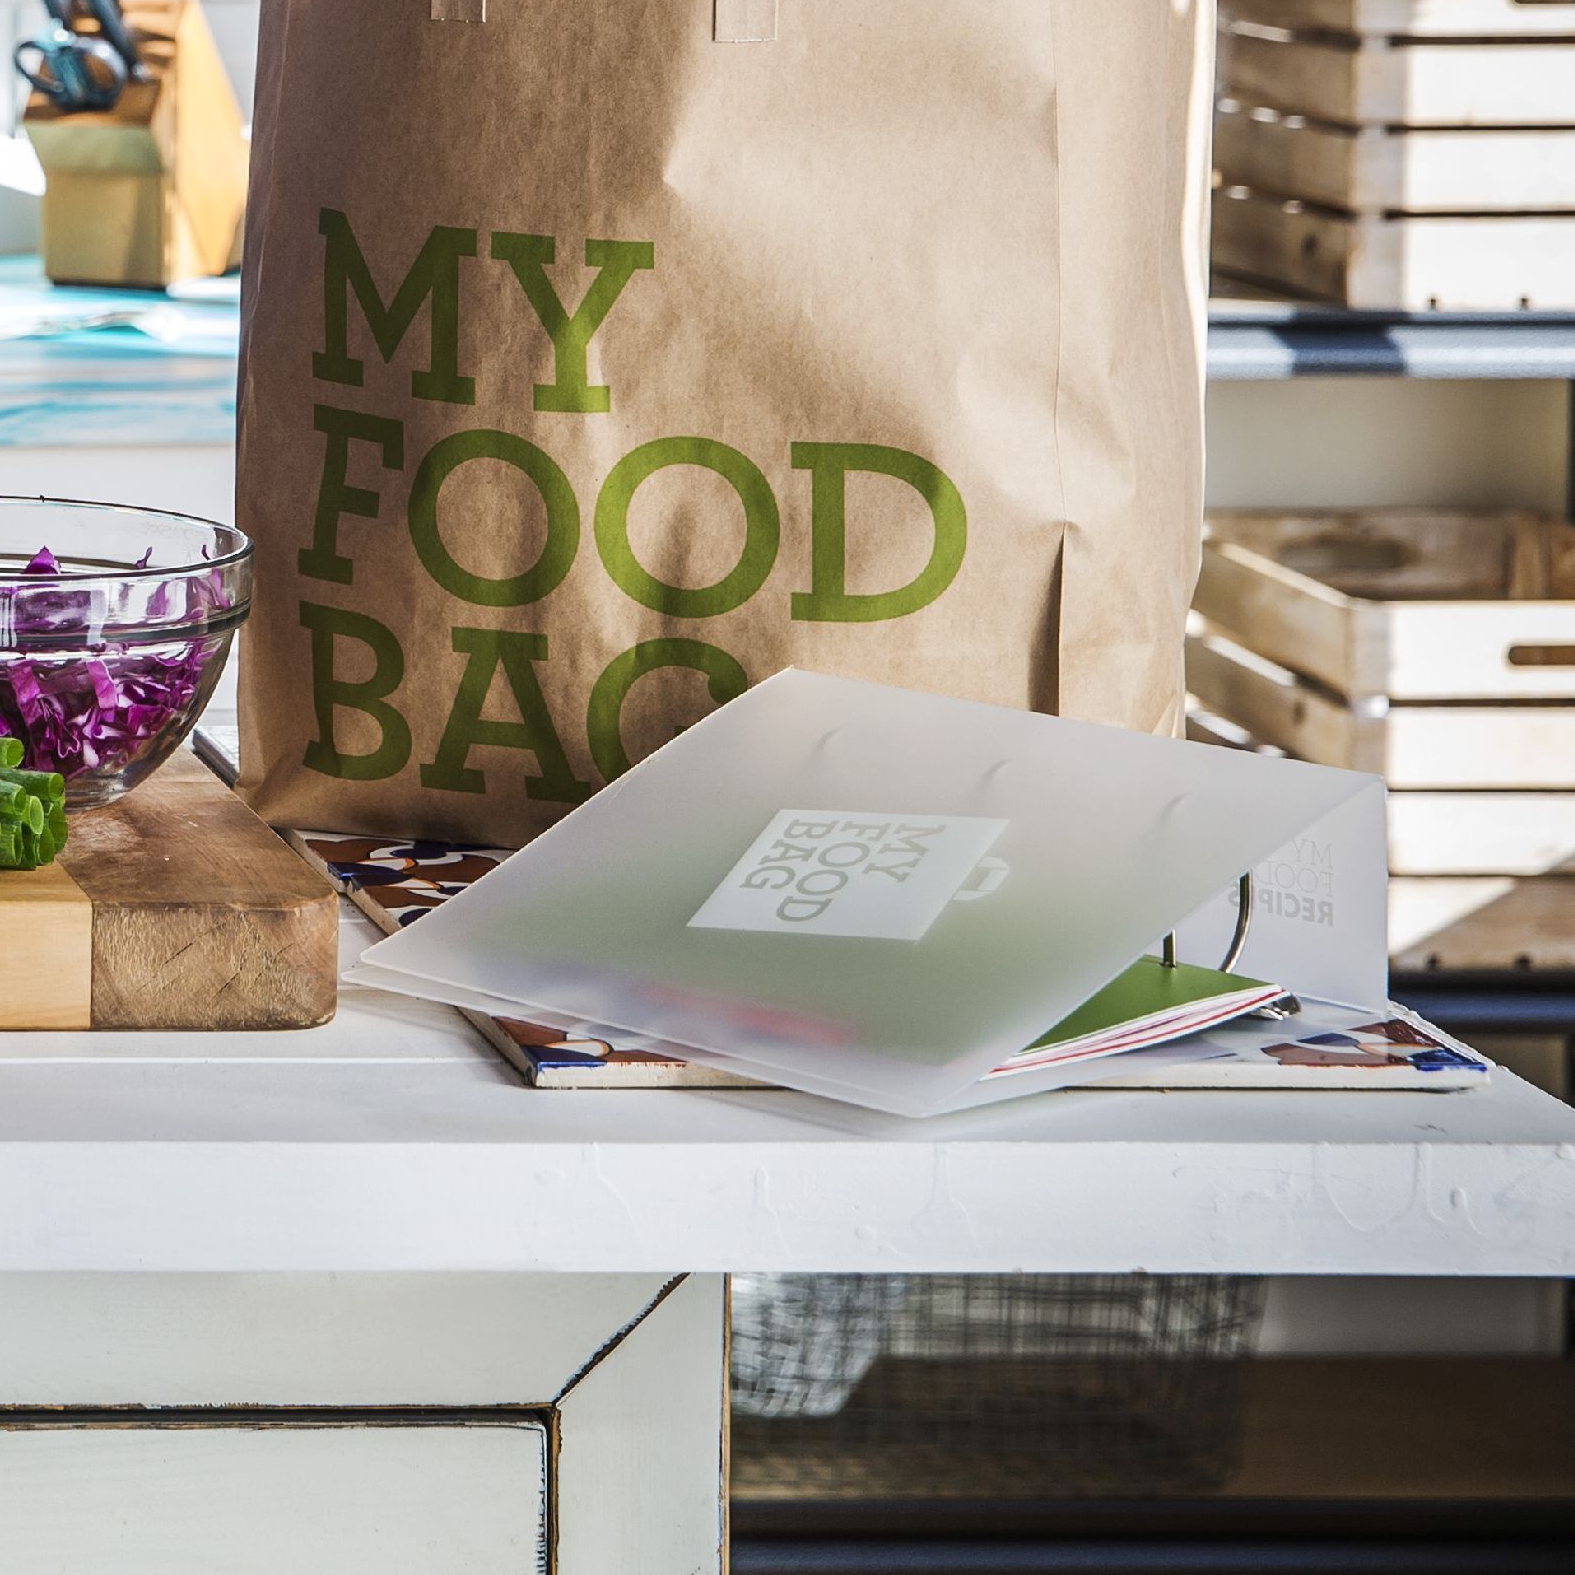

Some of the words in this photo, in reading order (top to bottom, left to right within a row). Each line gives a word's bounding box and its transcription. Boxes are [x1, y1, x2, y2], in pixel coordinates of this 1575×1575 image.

[312, 207, 654, 413] MY
[297, 404, 967, 622] FOOD
[739, 819, 840, 889] BAG
[776, 821, 889, 922] FOOD
[863, 823, 946, 883] MY
